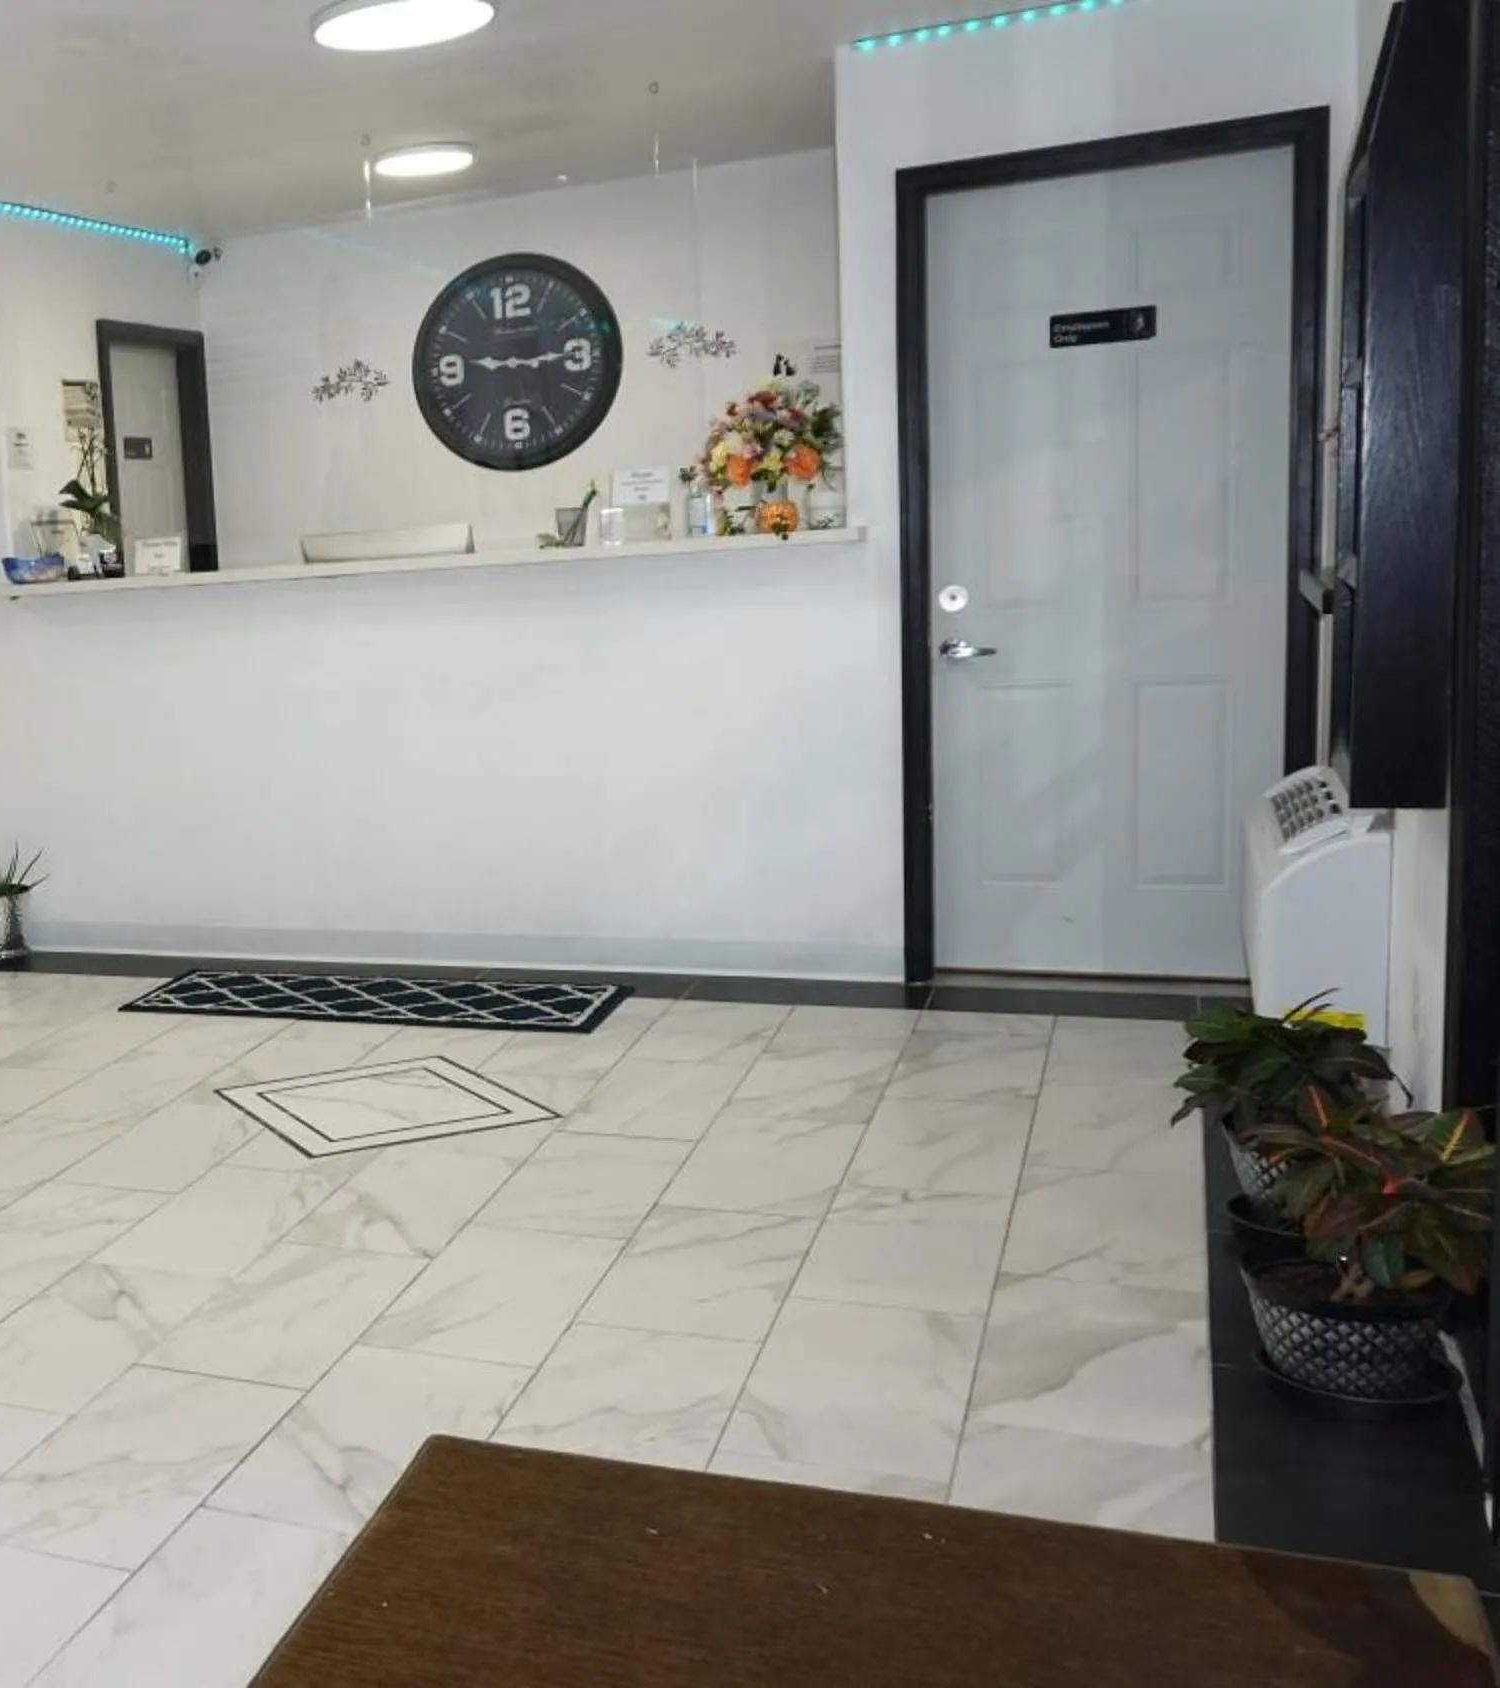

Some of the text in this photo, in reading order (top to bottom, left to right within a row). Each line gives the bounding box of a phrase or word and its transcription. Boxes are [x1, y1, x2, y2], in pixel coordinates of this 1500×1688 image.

[490, 283, 531, 319] 12
[439, 354, 465, 386] 9
[563, 338, 592, 371] 3
[503, 408, 531, 440] 6
